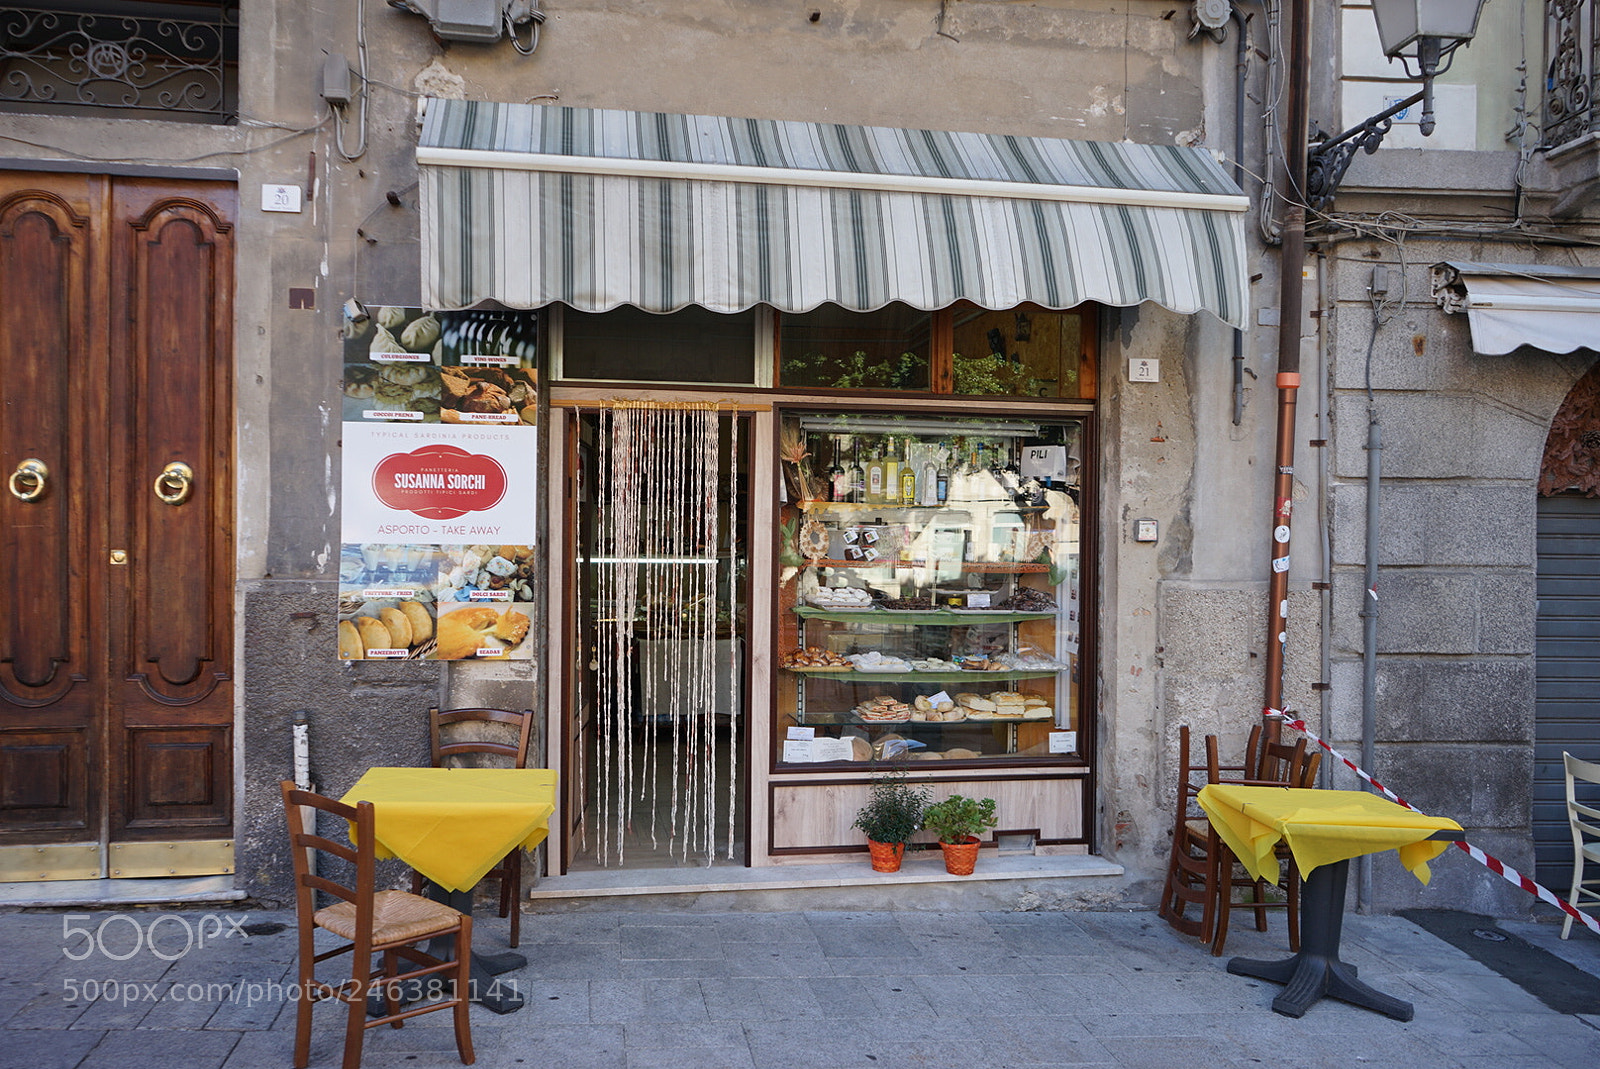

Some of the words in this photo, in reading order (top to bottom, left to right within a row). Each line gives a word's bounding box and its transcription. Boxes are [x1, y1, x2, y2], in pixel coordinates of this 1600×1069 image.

[274, 193, 289, 206] 20
[1138, 366, 1150, 377] 21
[461, 433, 511, 441] PRODUCTS
[394, 473, 445, 490] SUSANNA
[447, 474, 486, 490] SORCHI
[377, 524, 430, 535] ASPORTO
[441, 525, 466, 535] TAKE
[469, 526, 501, 536] AWAY
